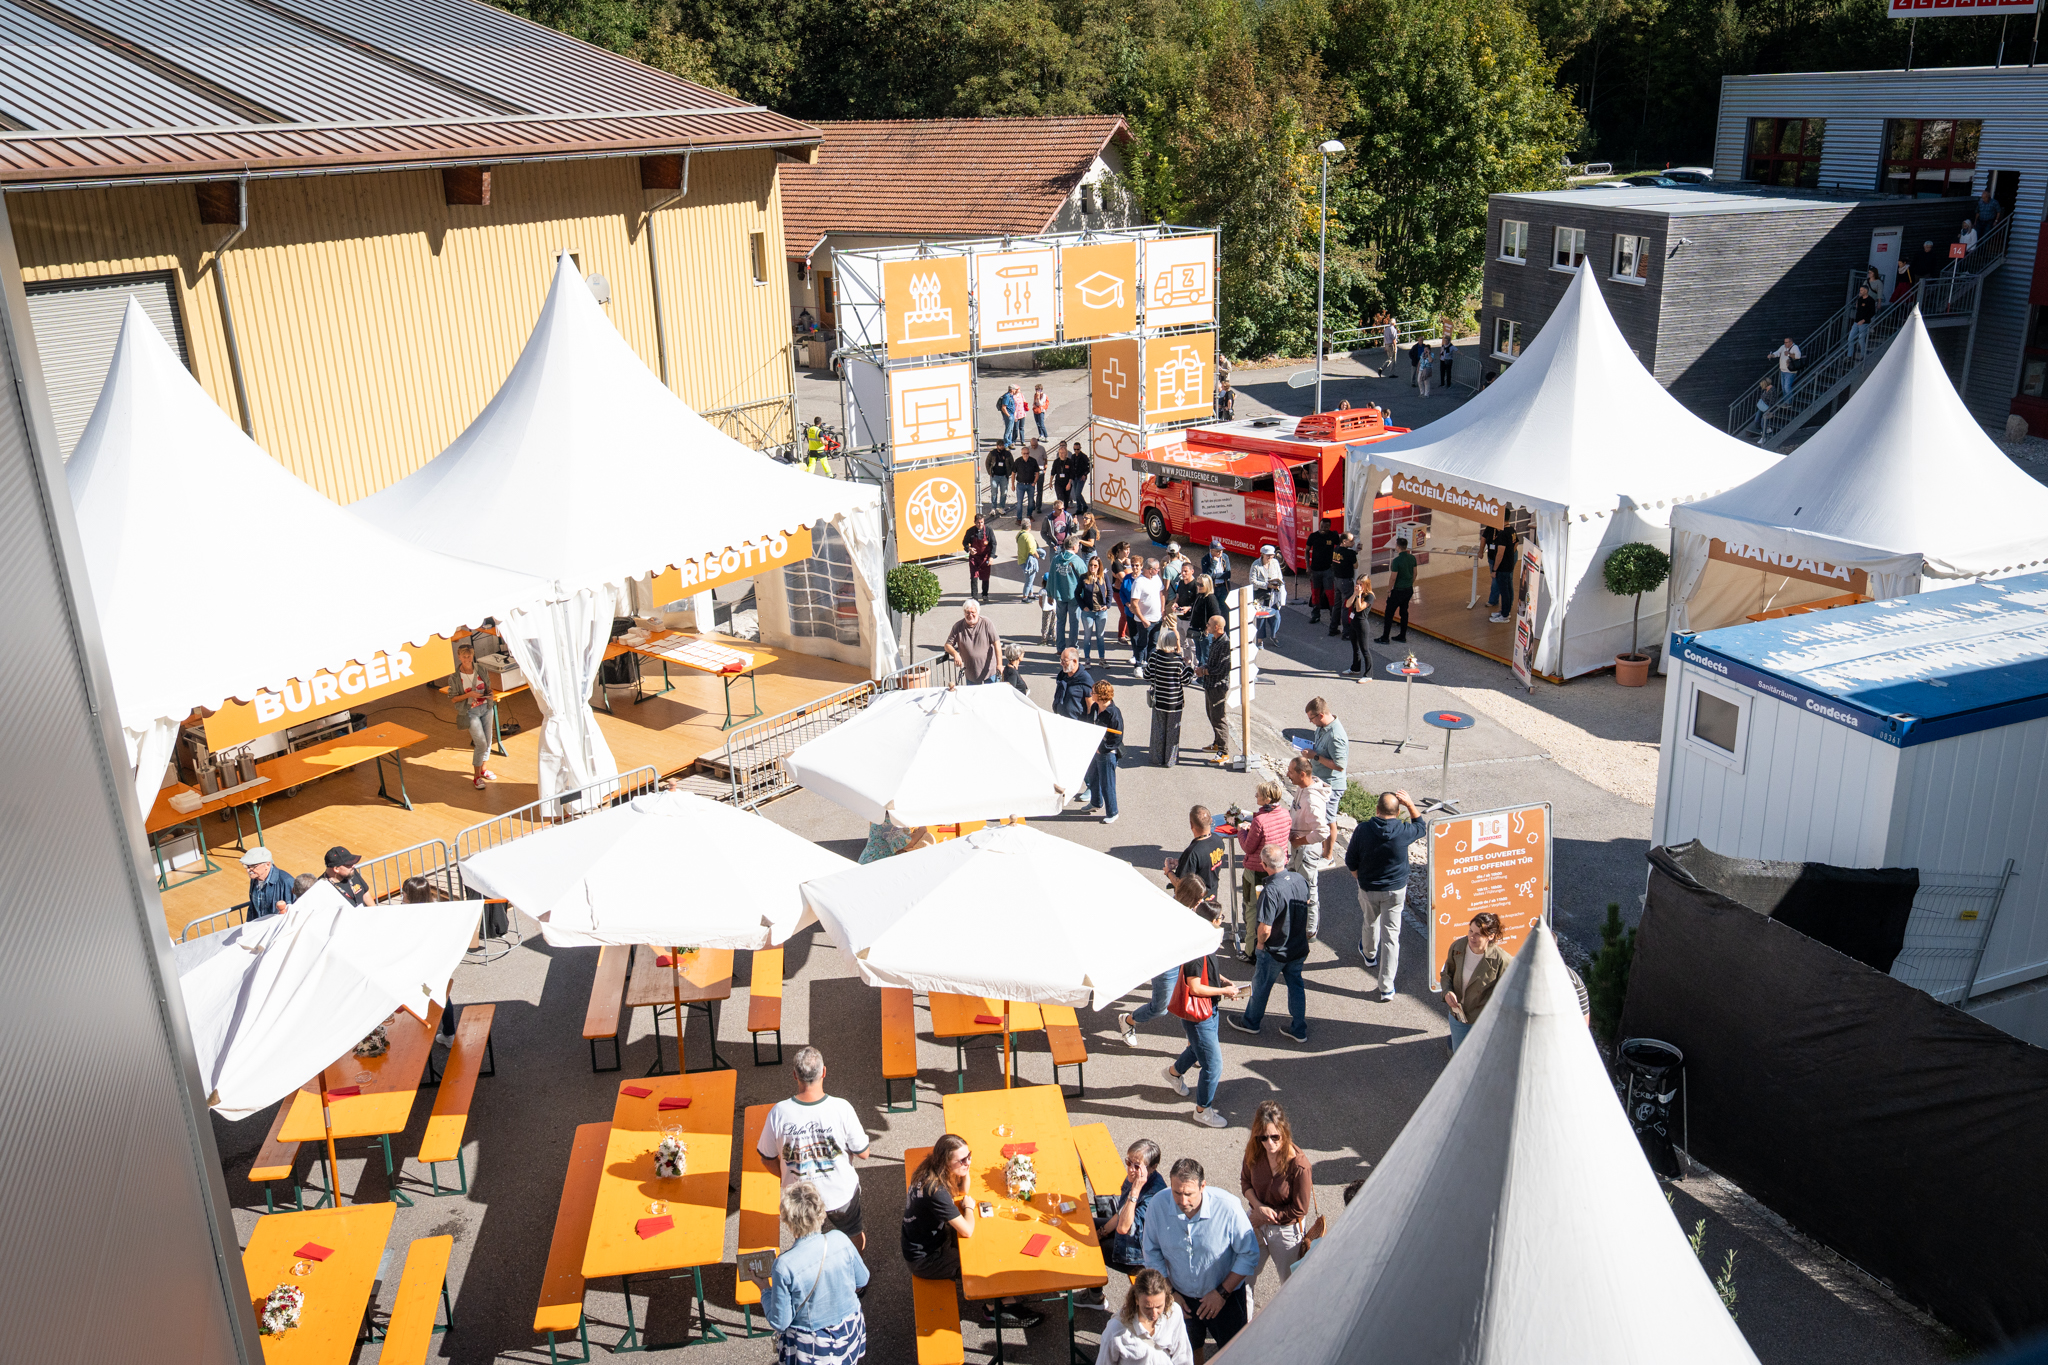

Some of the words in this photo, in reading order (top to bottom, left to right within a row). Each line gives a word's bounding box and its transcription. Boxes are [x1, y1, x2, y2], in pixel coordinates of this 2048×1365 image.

[1953, 247, 1962, 255] 14
[1161, 465, 1219, 484] WWW.PIZZALEGENDE.CH
[1397, 479, 1499, 517] ACCUEIL/EMPFANG
[680, 535, 788, 589] RISOTTO
[1724, 541, 1851, 583] MANDALA
[1684, 649, 1728, 675] Condecta
[254, 651, 414, 723] BURGER
[1757, 680, 1798, 702] Sanitärräume
[1805, 698, 1858, 727] Condecta
[1879, 728, 1901, 745] 08361
[1446, 867, 1461, 876] TAG
[1463, 865, 1479, 874] DER
[1480, 859, 1516, 870] OFFENEN
[1517, 856, 1533, 865] TÜR
[1453, 854, 1484, 865] PORTES
[1485, 848, 1526, 859] OUVERTES
